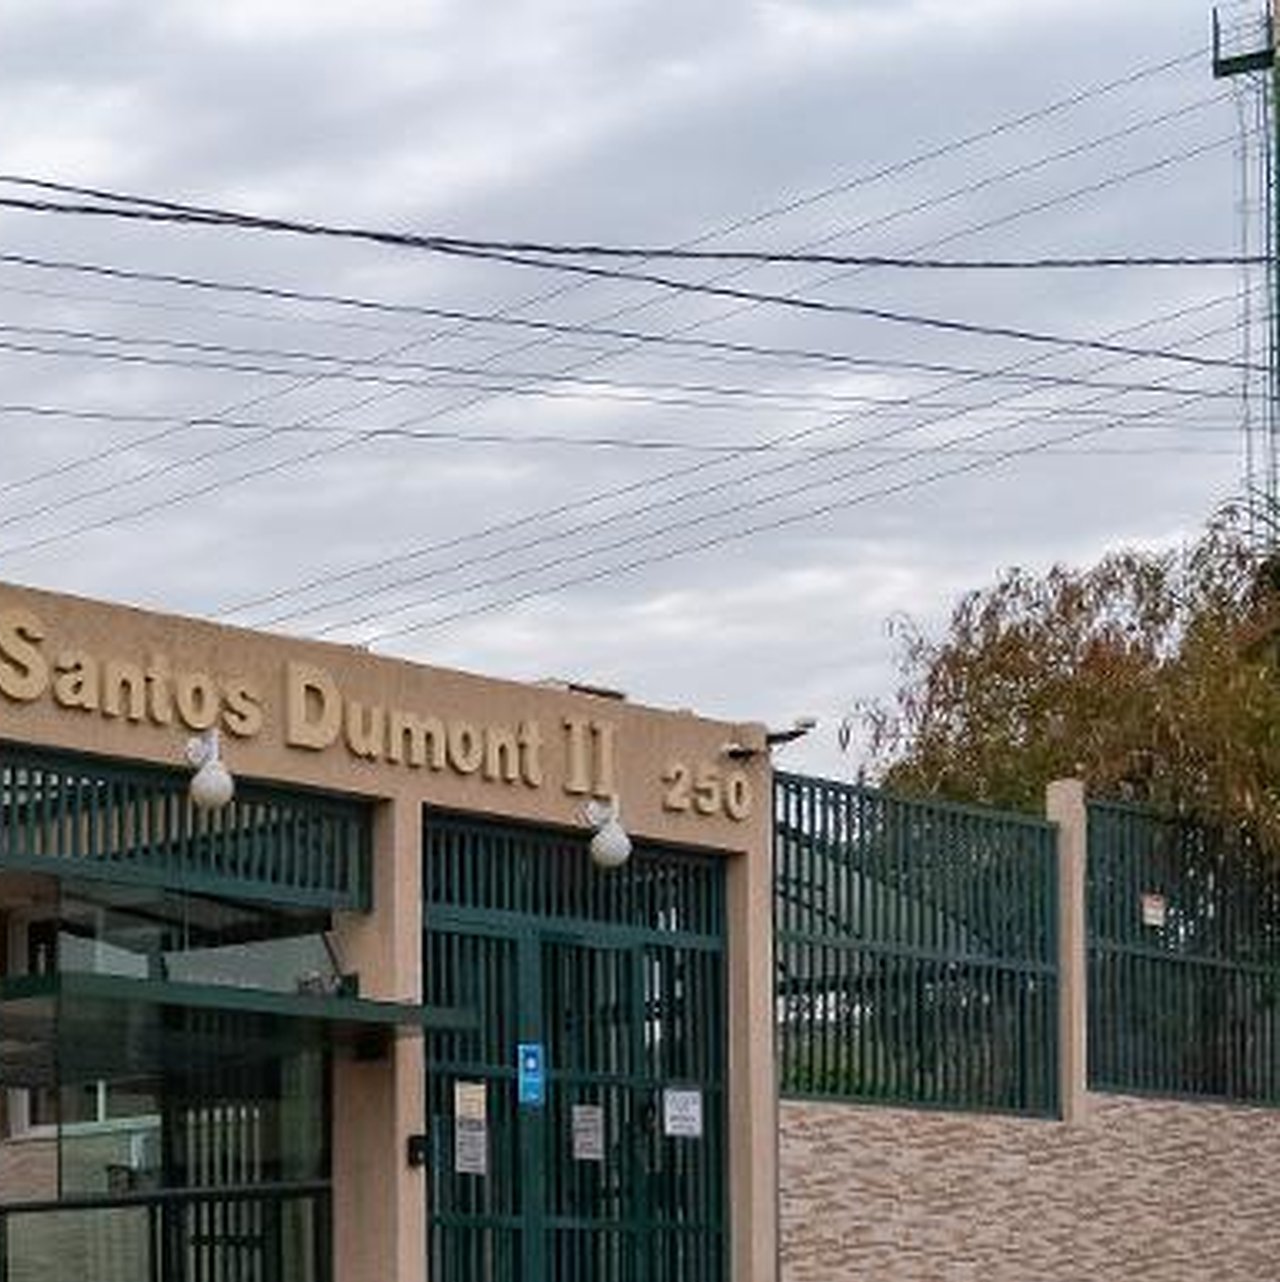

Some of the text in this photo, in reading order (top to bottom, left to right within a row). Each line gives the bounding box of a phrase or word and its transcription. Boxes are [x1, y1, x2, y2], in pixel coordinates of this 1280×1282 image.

[286, 663, 544, 788] Dumont
[562, 717, 614, 797] II
[662, 766, 752, 821] 250
